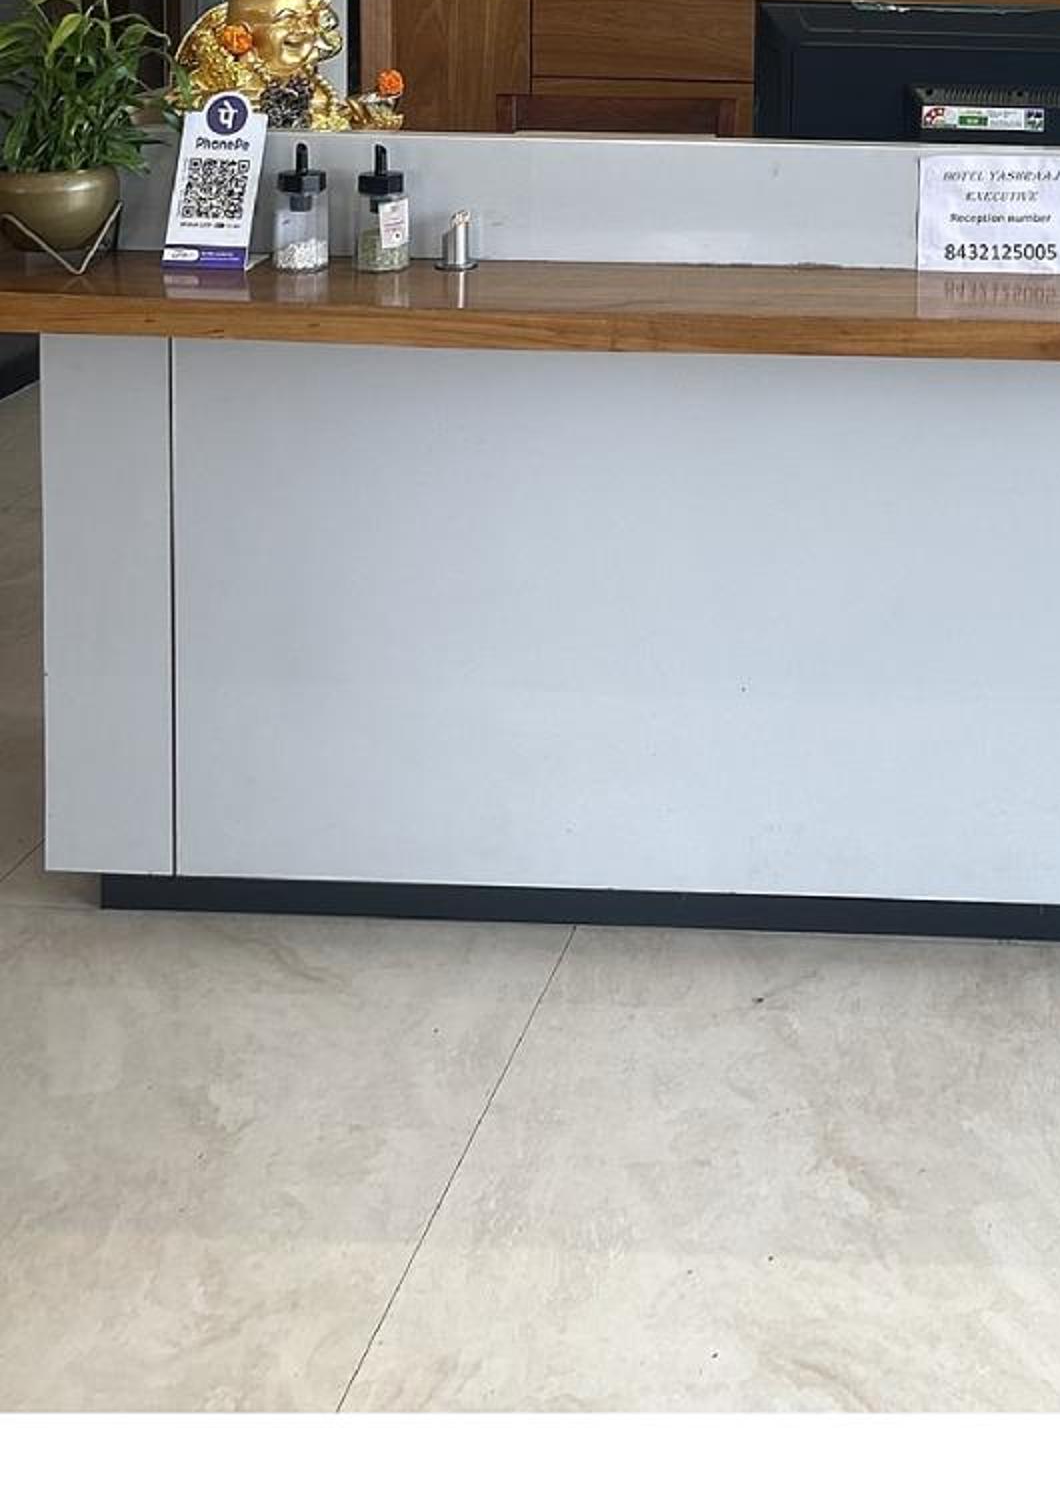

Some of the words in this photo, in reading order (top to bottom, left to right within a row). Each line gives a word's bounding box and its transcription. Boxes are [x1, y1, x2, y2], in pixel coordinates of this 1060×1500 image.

[218, 100, 239, 129] पे
[195, 137, 250, 151] PhonePe
[943, 170, 984, 181] HOTEL
[965, 191, 1040, 202] EXECUTIVE
[949, 213, 1005, 225] Reception
[1007, 213, 1051, 223] number
[943, 243, 1058, 261] 8432125005
